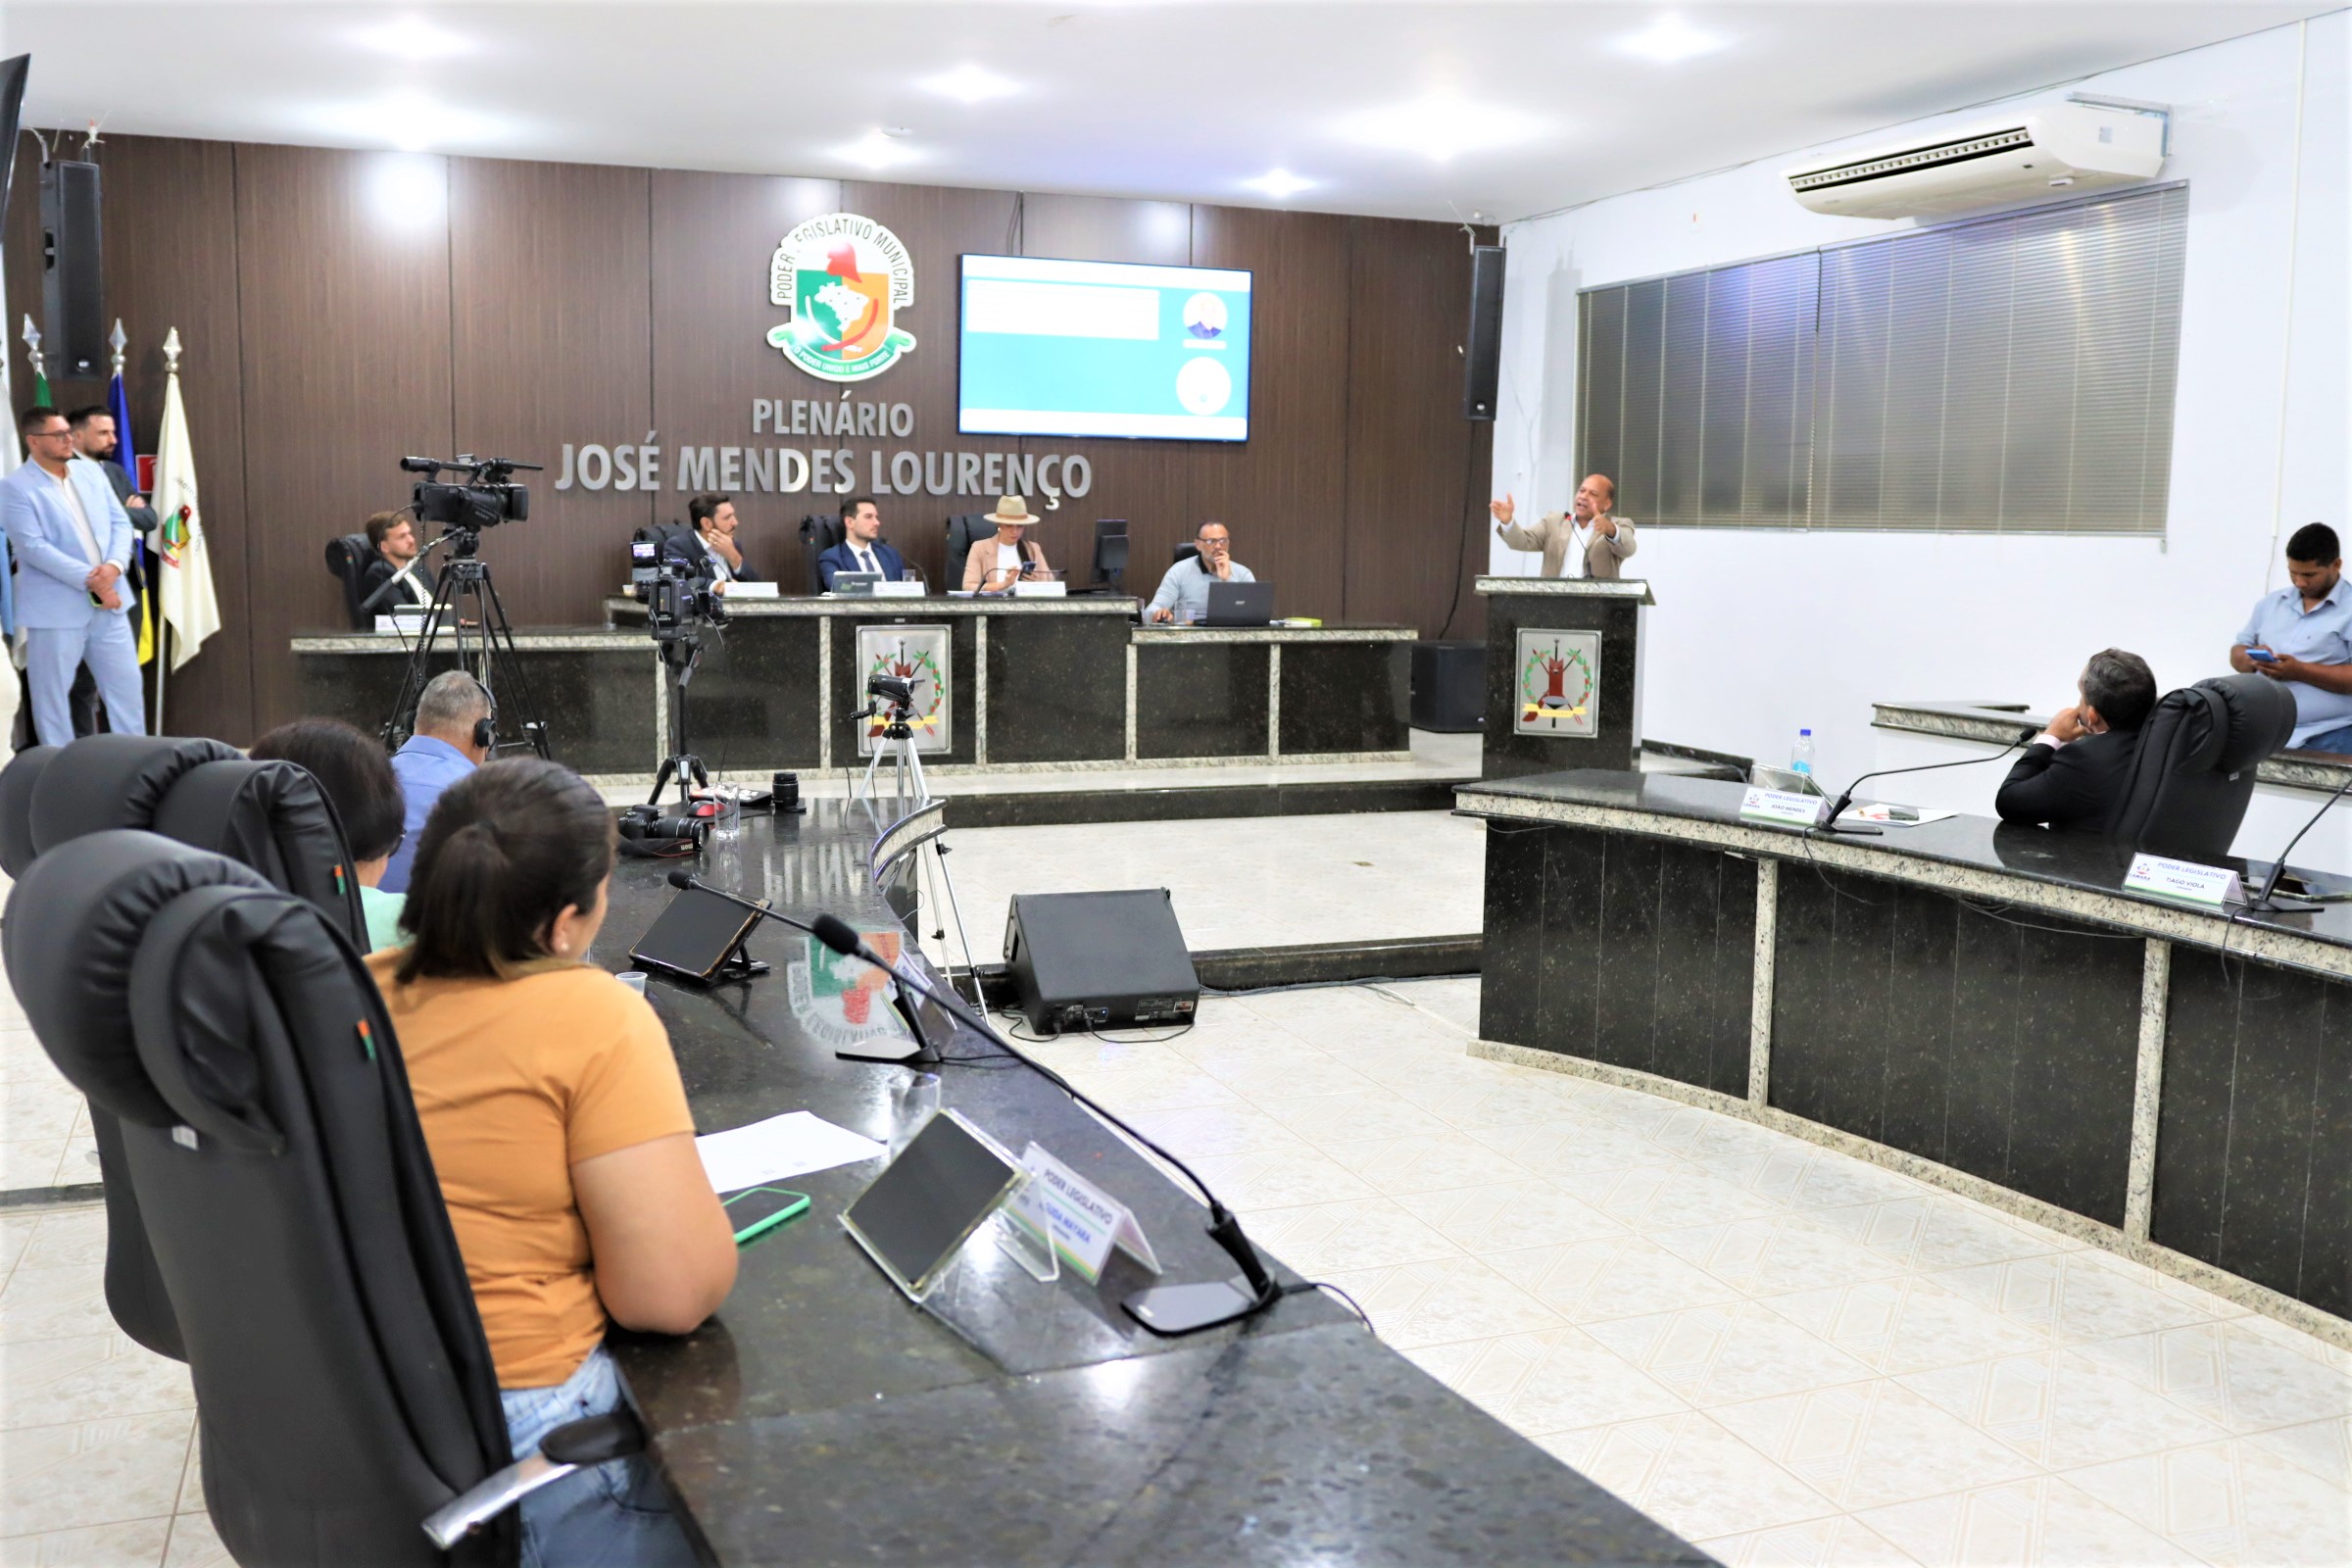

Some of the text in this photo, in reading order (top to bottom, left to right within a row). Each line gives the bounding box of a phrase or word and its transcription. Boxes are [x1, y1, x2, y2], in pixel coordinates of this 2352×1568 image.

[776, 219, 908, 304] PODER EGISLATIVO MUNICIPAL
[753, 390, 914, 437] PLENÁRIO
[555, 430, 1093, 511] JOSÉ MENDES LOURENÇO
[1783, 795, 1818, 806] LEGISLATIVO
[2157, 862, 2227, 880] PODER LEGISLATIVO
[1044, 1168, 1066, 1193] PODER
[1065, 1184, 1113, 1225] LEGISLATIVO
